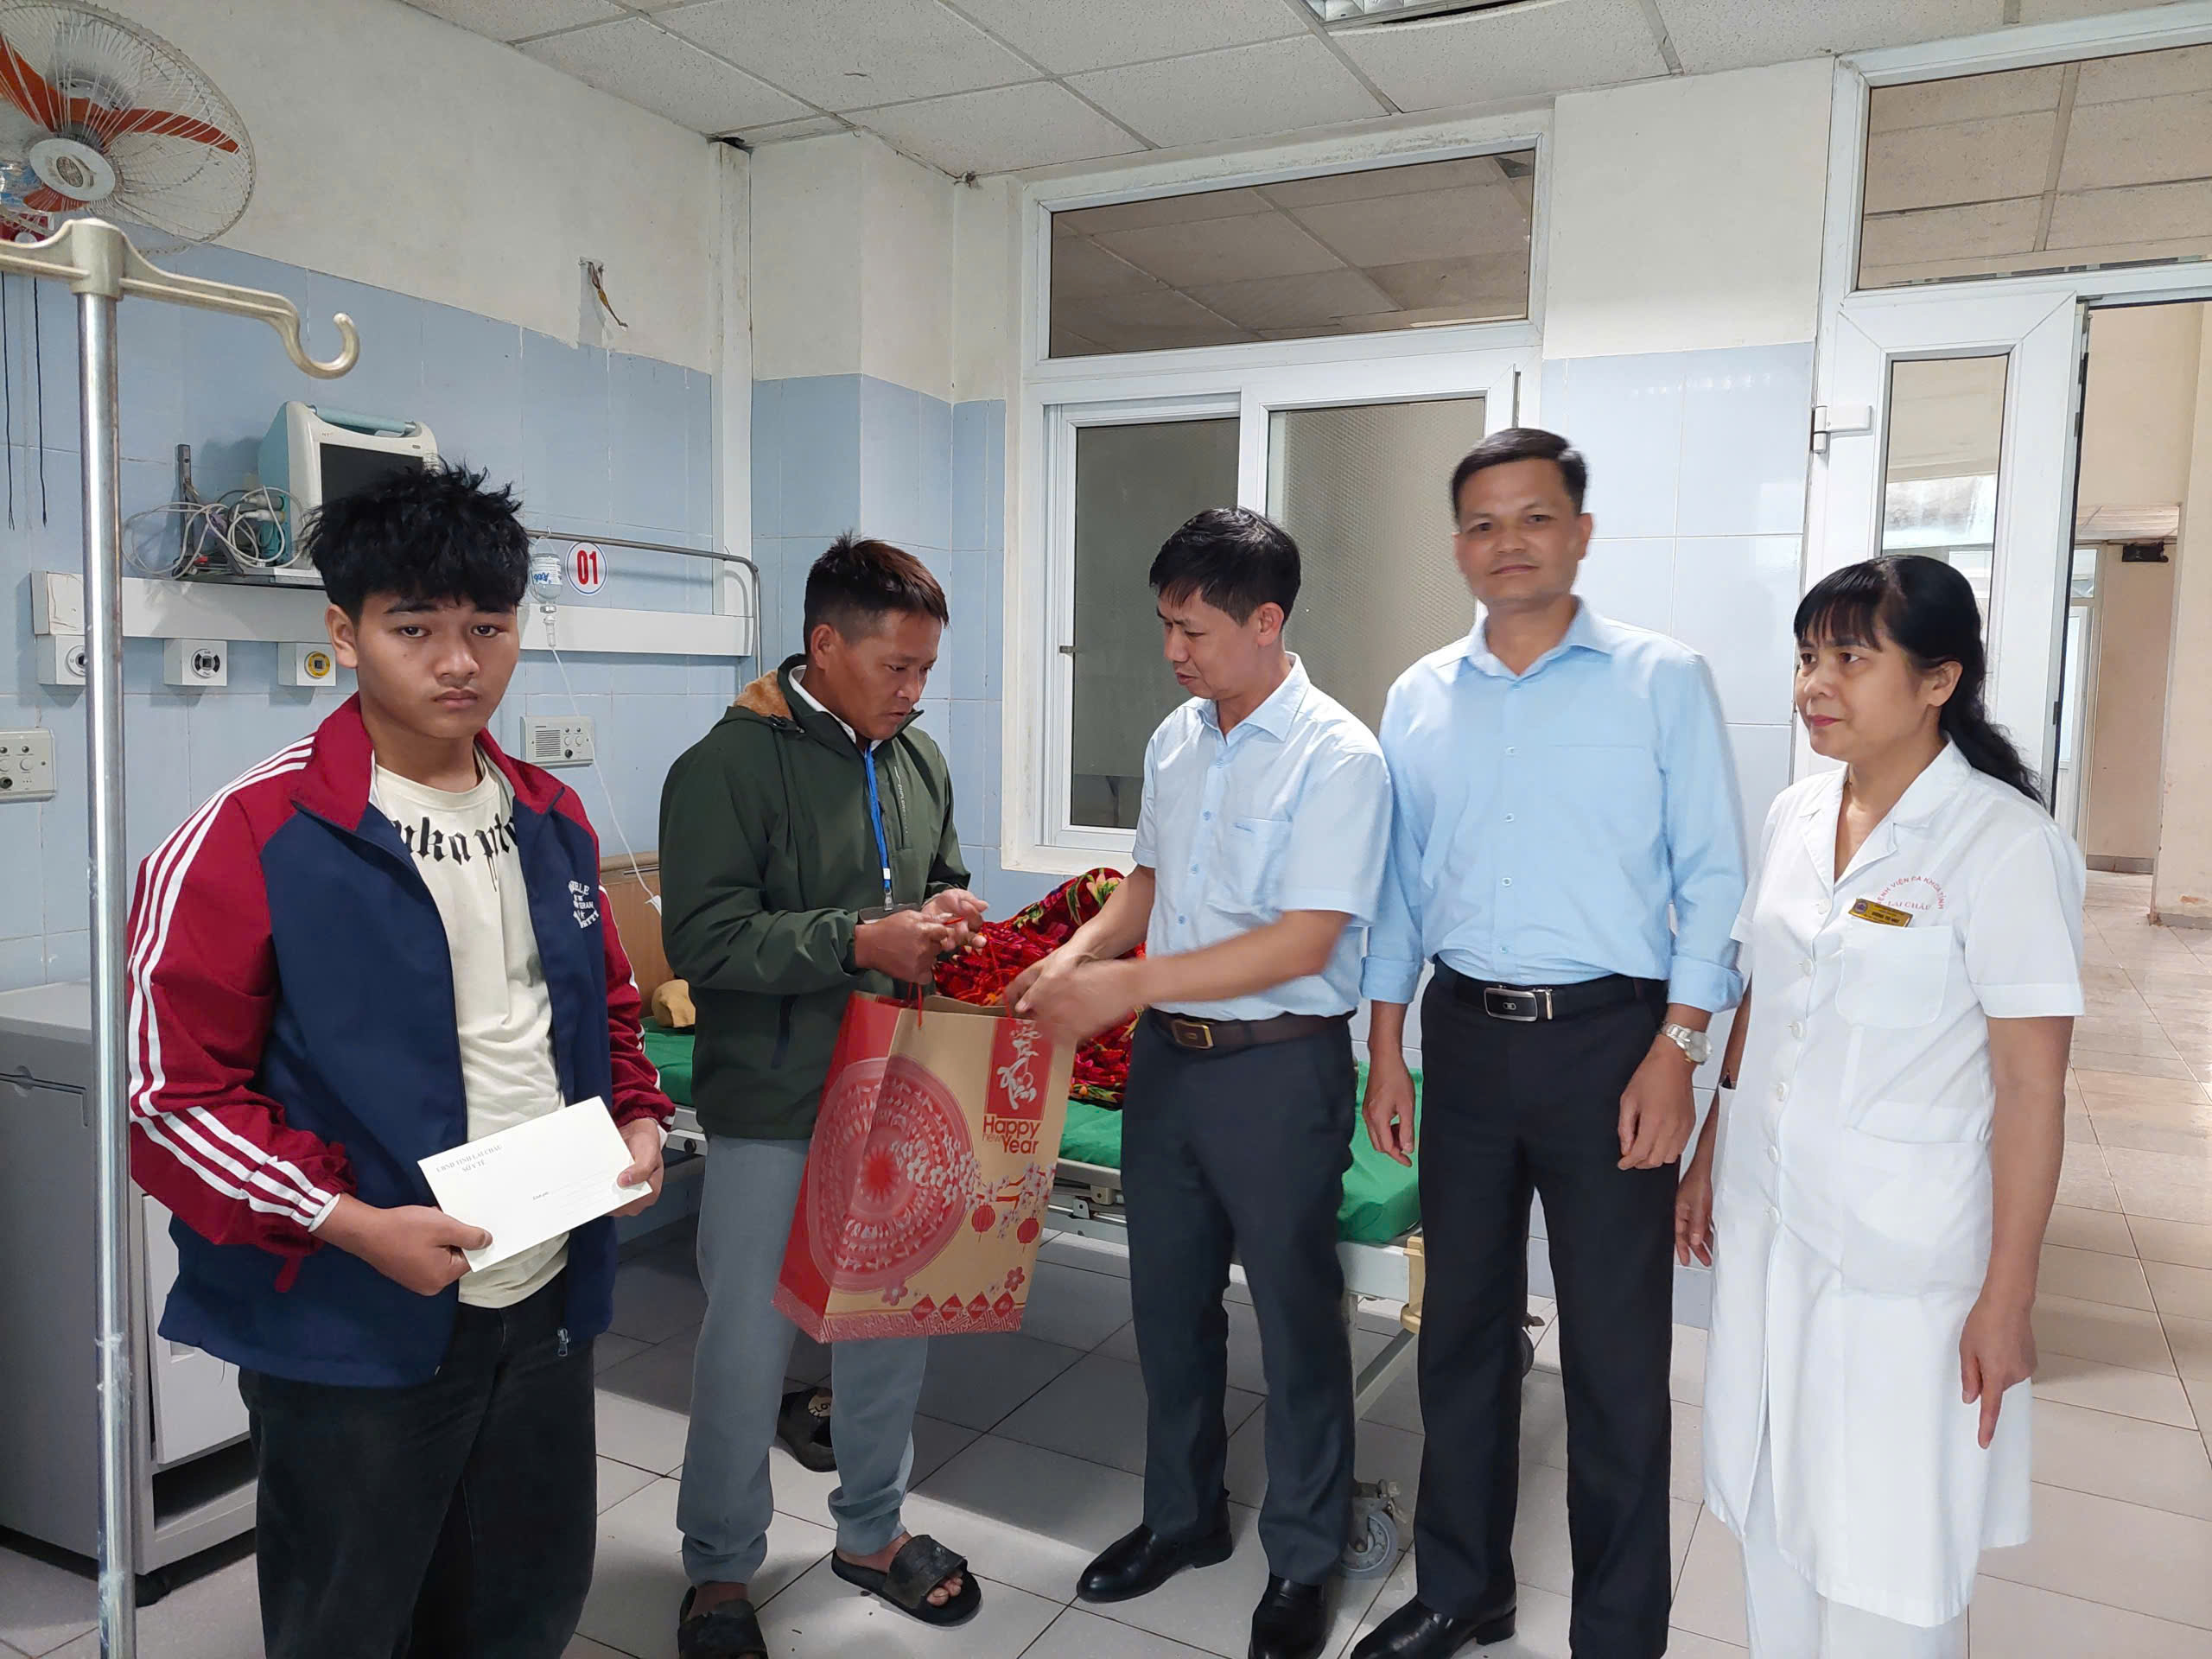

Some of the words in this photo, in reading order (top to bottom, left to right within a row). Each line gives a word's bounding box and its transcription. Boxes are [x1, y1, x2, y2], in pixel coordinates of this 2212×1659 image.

[577, 550, 598, 585] 01
[982, 1116, 1041, 1140] Happy
[982, 1133, 1001, 1143] new
[1001, 1134, 1039, 1155] Year
